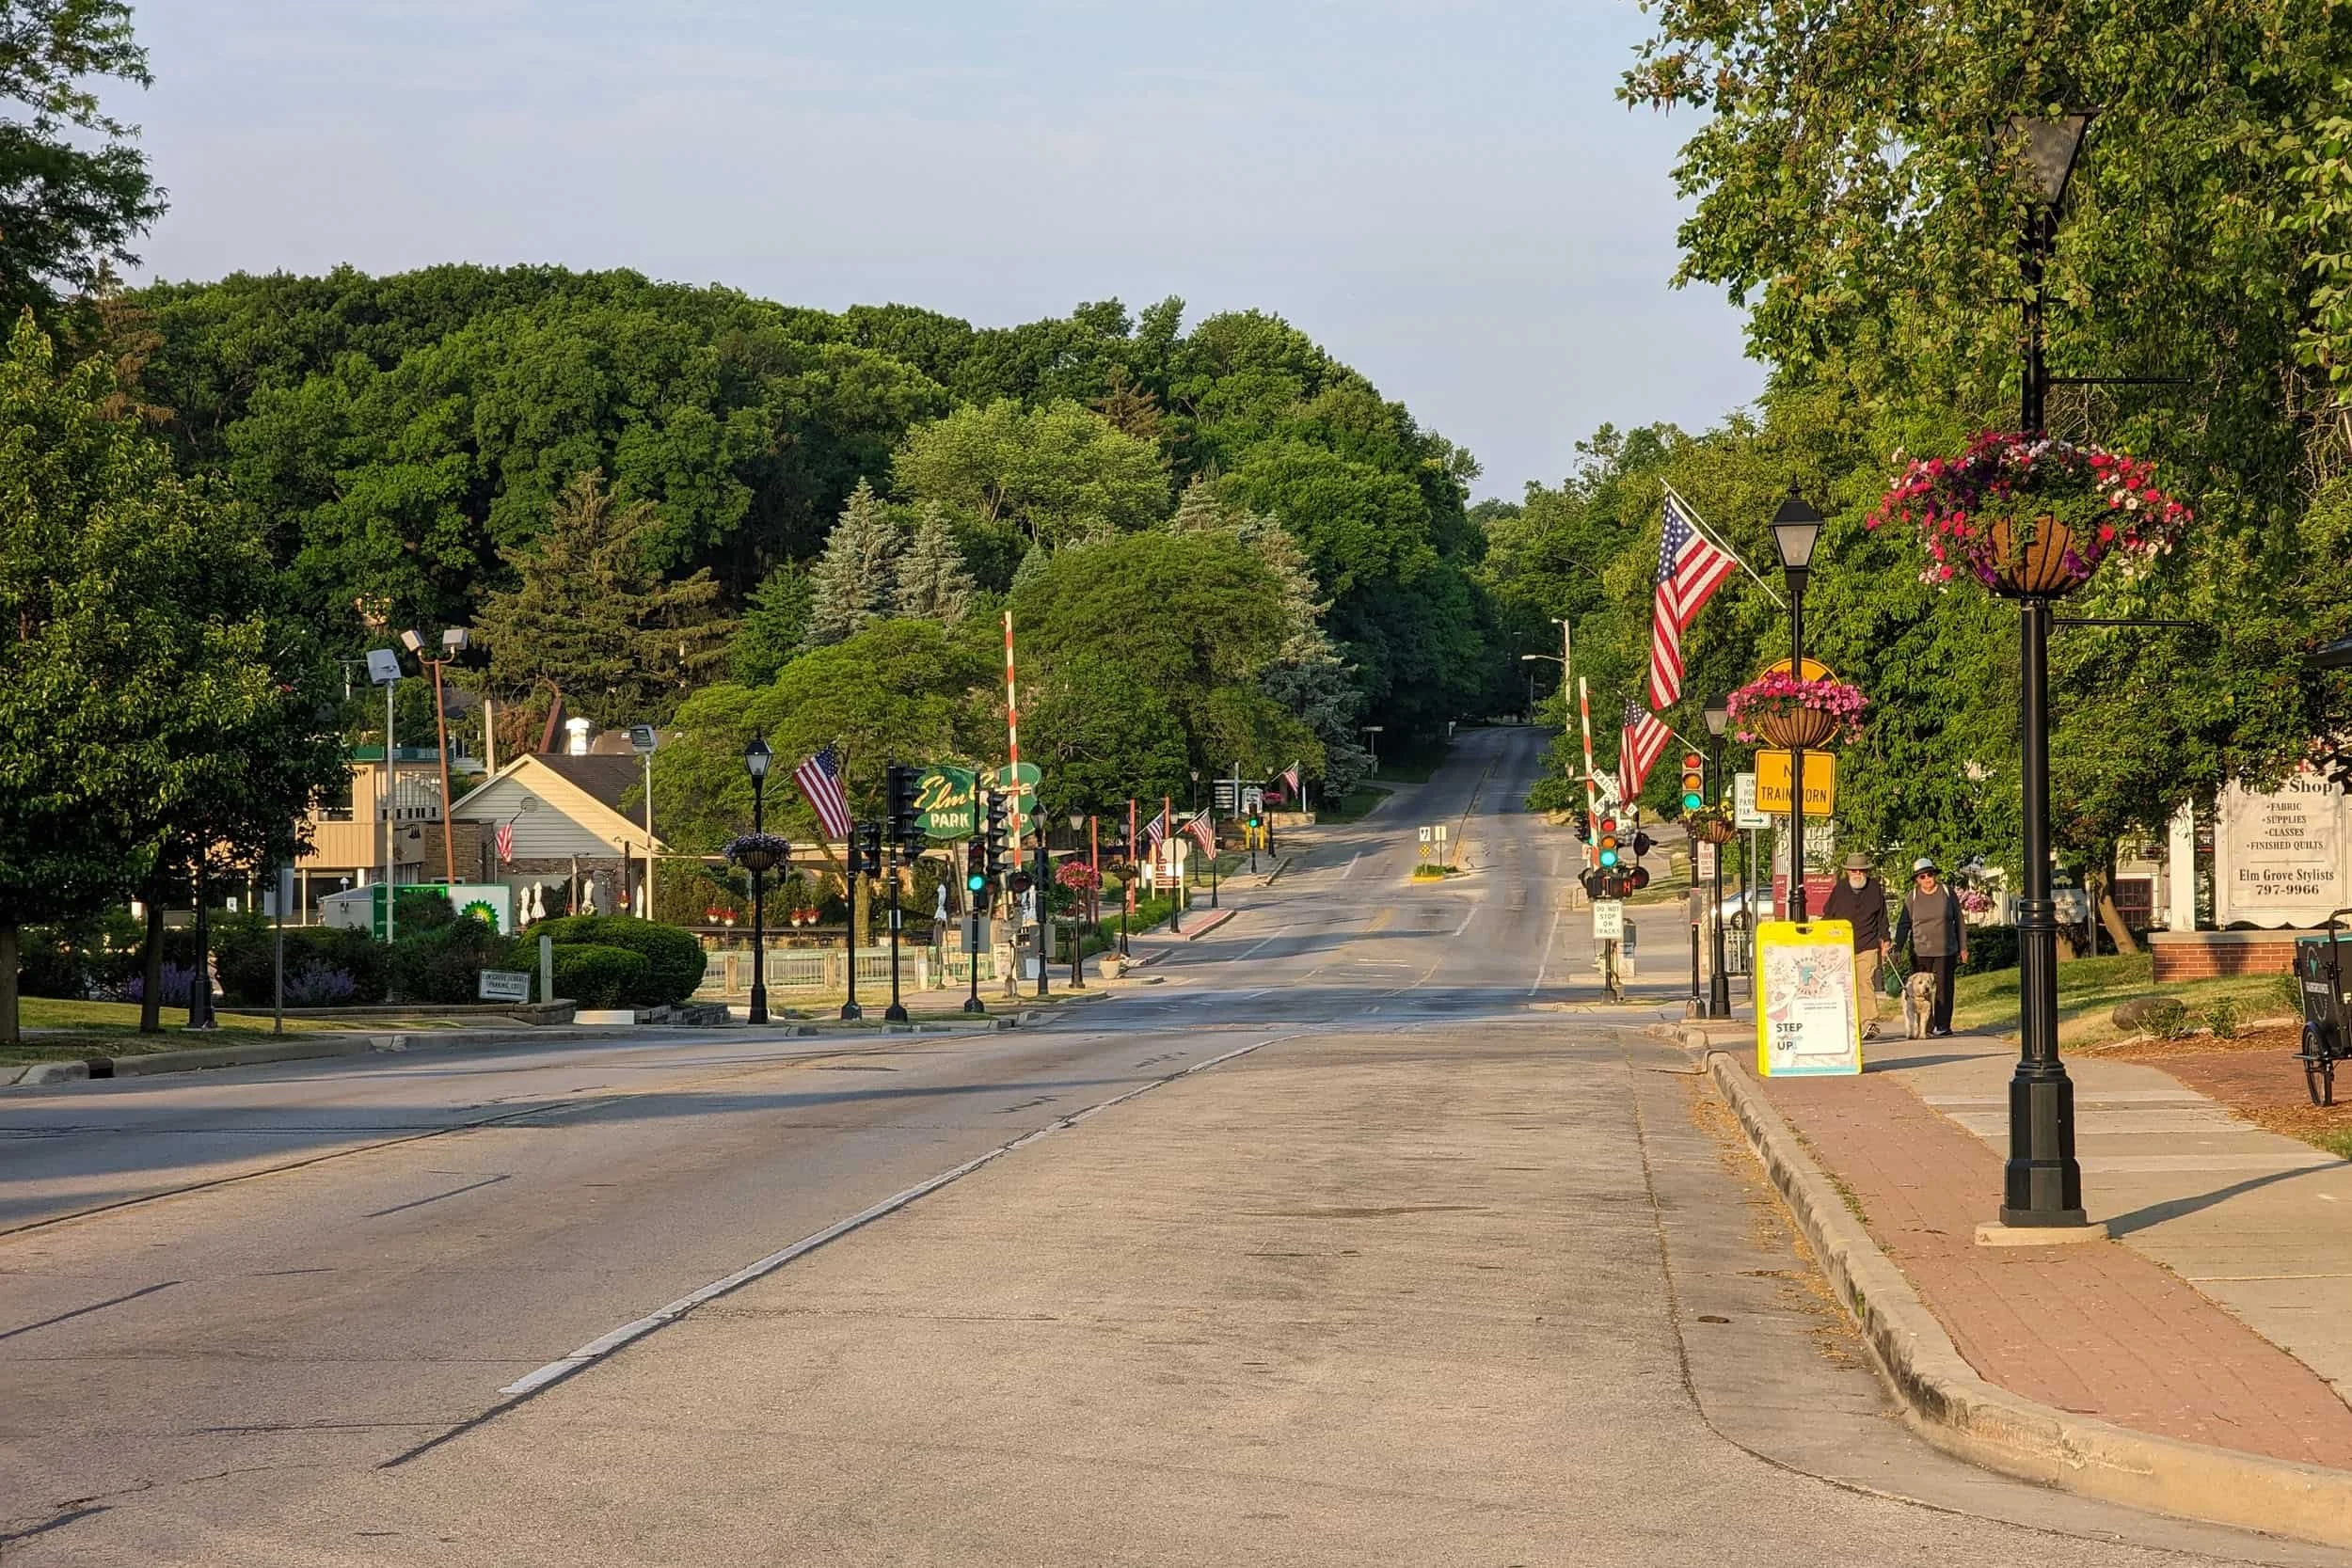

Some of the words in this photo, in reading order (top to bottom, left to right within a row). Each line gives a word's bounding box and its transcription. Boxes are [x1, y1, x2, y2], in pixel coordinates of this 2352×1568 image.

[914, 775, 966, 812] Elm
[2289, 780, 2333, 796] Shop
[1761, 786, 1791, 802] TRAIN
[930, 813, 969, 828] PARK
[2266, 815, 2307, 824] SUPPLIES
[2268, 828, 2305, 837] CLASSES
[2250, 841, 2292, 850] FINISHED
[2294, 841, 2324, 851] QUILTS
[2239, 869, 2260, 881] Elm
[2264, 869, 2294, 881] Grove
[2296, 868, 2334, 883] Stylists
[2255, 885, 2320, 895] 797-9966
[1776, 1022, 1803, 1033] STEP
[1777, 1041, 1793, 1051] UP
